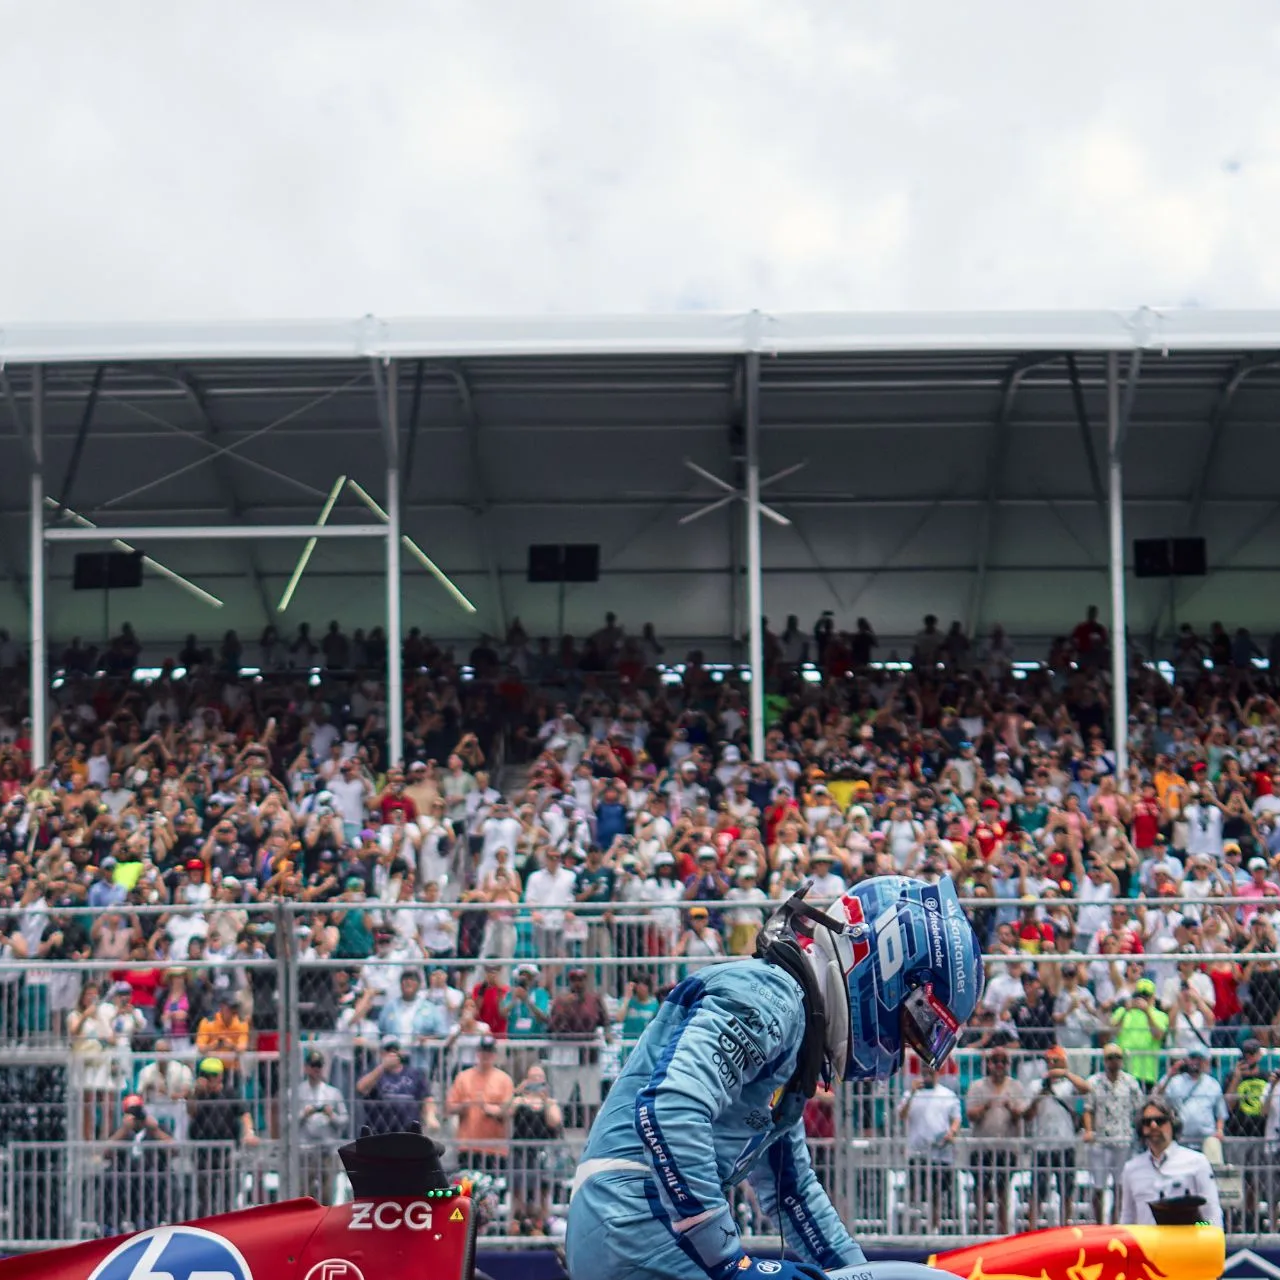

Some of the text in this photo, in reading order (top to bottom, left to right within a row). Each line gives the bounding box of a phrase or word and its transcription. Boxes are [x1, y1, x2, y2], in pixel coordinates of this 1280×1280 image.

[950, 918, 967, 995] Santander
[727, 1017, 767, 1067] PIRELLI
[638, 1105, 689, 1203] RICHARD MILLE
[348, 1201, 433, 1230] ZCG
[801, 1221, 825, 1254] MILLE
